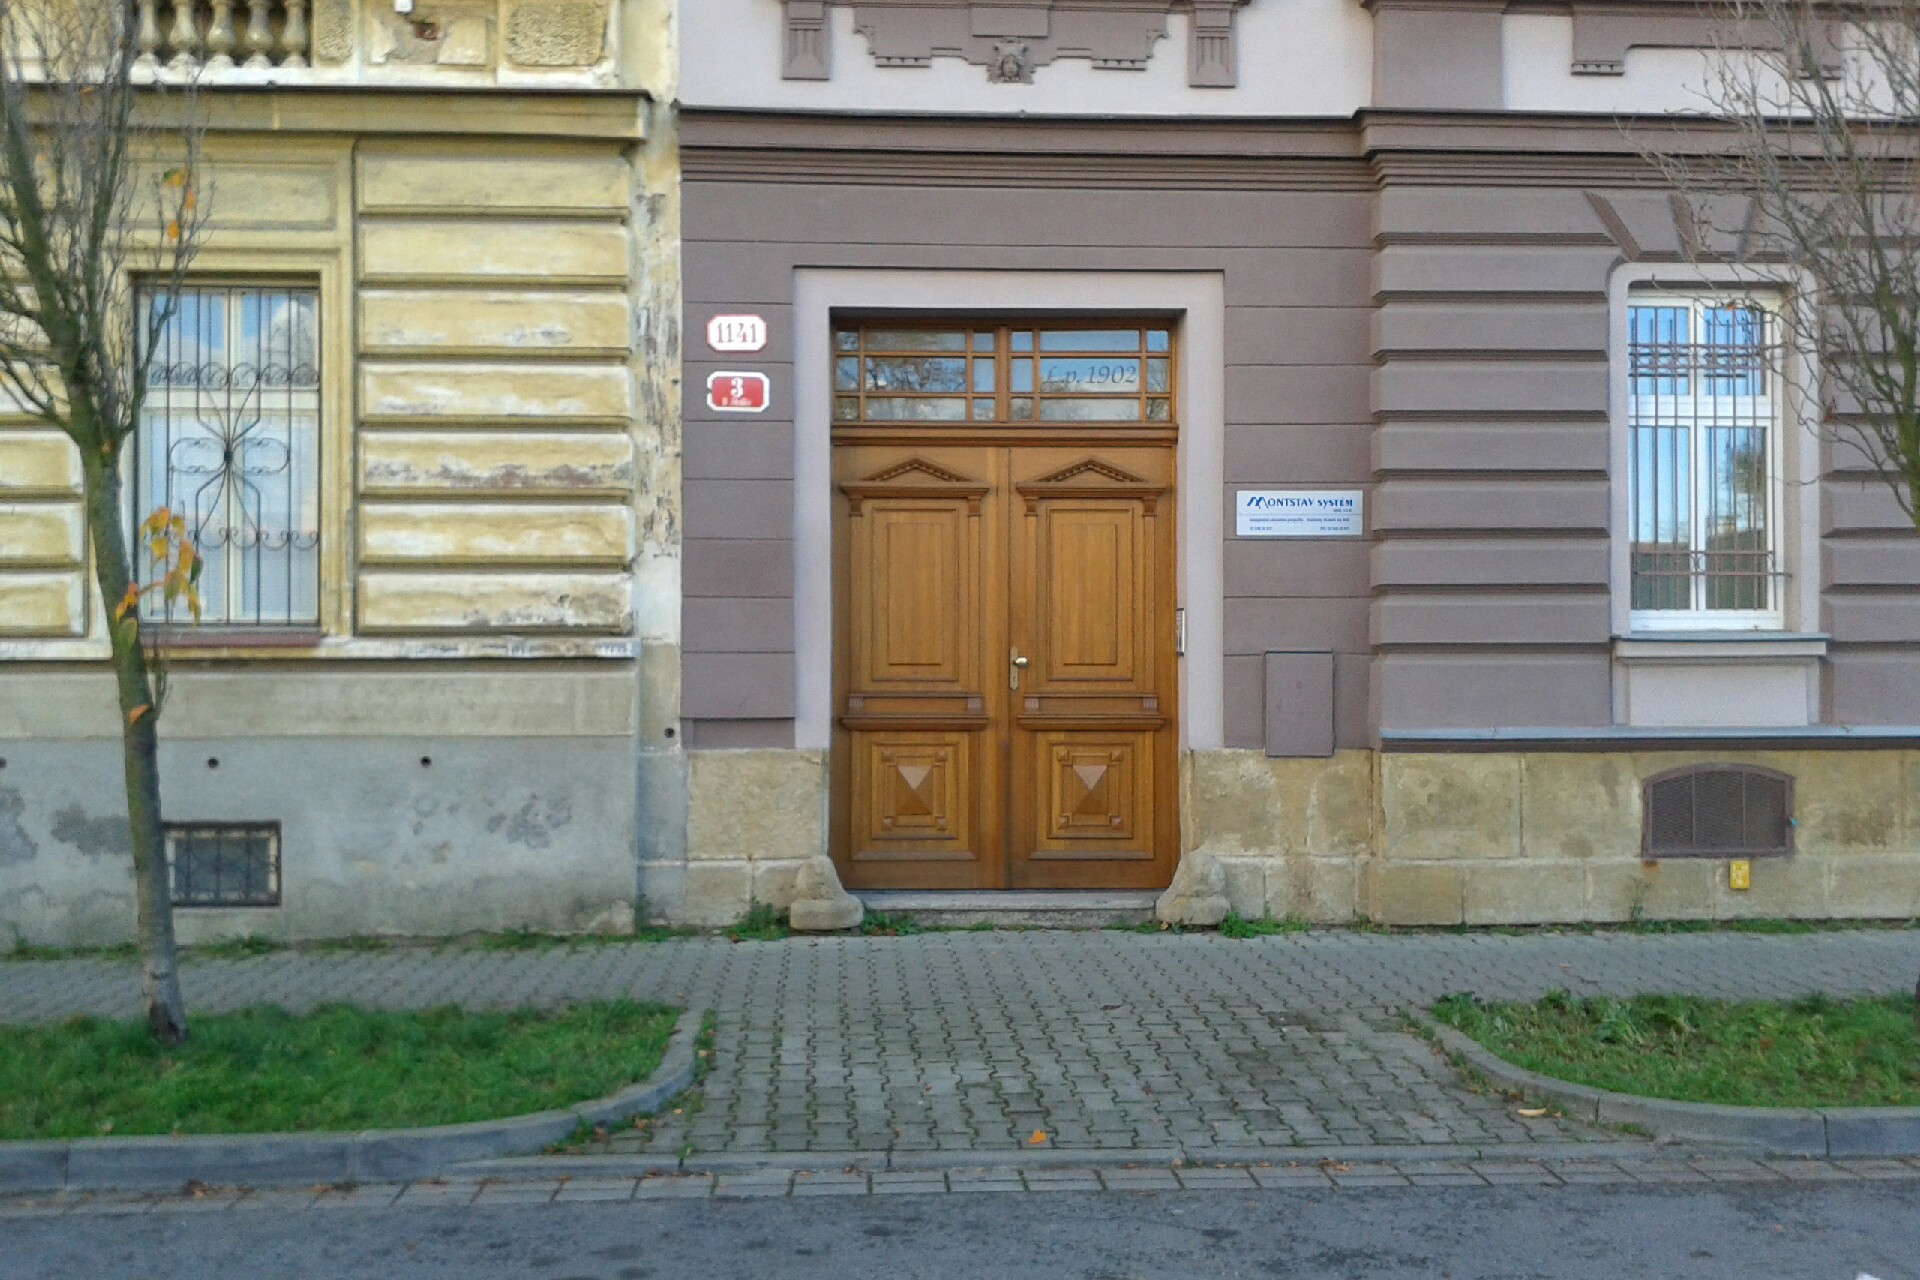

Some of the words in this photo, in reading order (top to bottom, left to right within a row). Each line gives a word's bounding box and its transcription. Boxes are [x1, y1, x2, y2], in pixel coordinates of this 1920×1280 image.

[717, 322, 757, 343] 1141
[1085, 365, 1137, 384] 1902
[730, 377, 744, 398] 3
[1247, 496, 1314, 509] MONTSTAV
